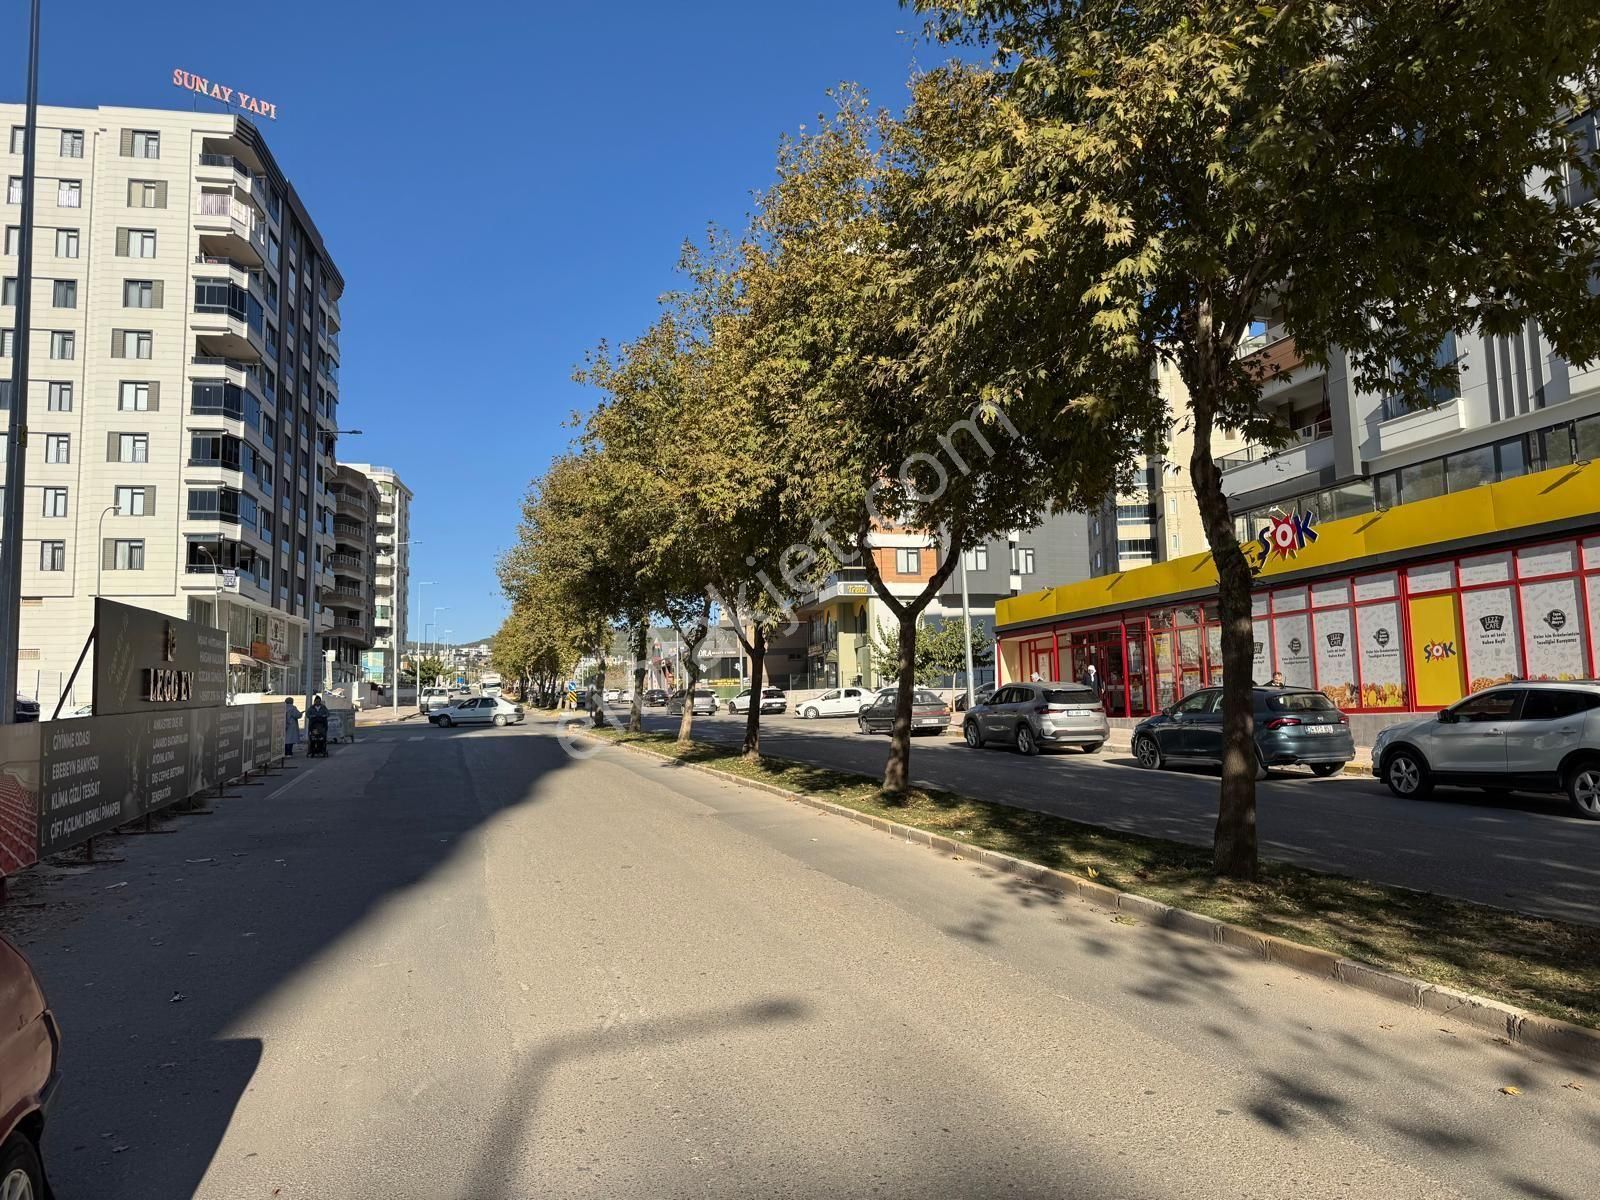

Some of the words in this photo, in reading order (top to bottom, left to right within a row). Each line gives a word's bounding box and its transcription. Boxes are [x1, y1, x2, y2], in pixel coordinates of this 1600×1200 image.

[173, 68, 233, 103] SUNAY
[238, 91, 277, 120] YAPI
[1257, 508, 1319, 569] ŞOK
[1424, 641, 1456, 663] ŞOK
[53, 729, 75, 751] GİYİNME
[75, 730, 91, 746] ODASI
[77, 755, 99, 774] BANYOSU
[51, 786, 69, 810] KLİMA
[69, 781, 82, 805] GİZLİ
[82, 778, 101, 800] TESİSAT
[50, 817, 63, 845] ÇİFT
